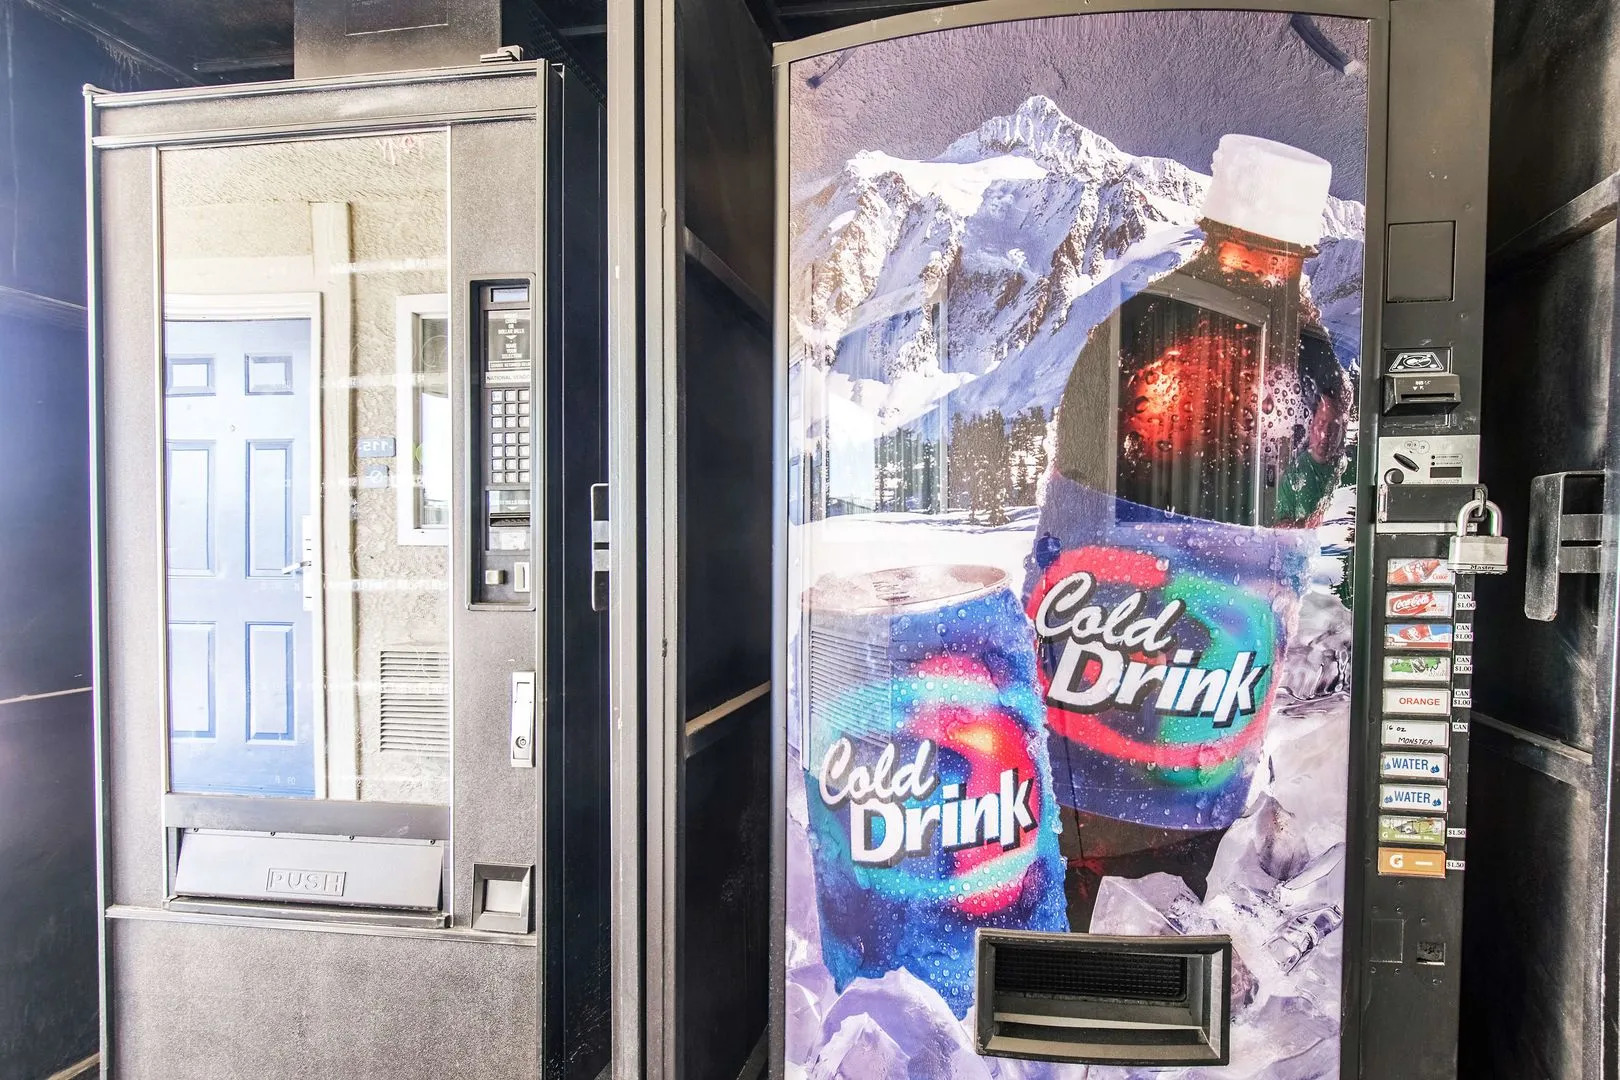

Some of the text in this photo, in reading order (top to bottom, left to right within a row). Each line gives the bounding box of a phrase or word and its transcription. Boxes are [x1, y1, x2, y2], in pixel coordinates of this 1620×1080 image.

[1036, 571, 1185, 652] Cold
[1047, 636, 1268, 728] Drink
[1399, 697, 1440, 706] ORANGE
[1398, 737, 1434, 745] MONSTER
[1392, 757, 1429, 770] WATER
[819, 737, 939, 809] Cold
[1394, 791, 1431, 803] WATER
[850, 768, 1037, 868] Drink
[1389, 854, 1404, 869] G
[270, 871, 339, 892] PUSH
